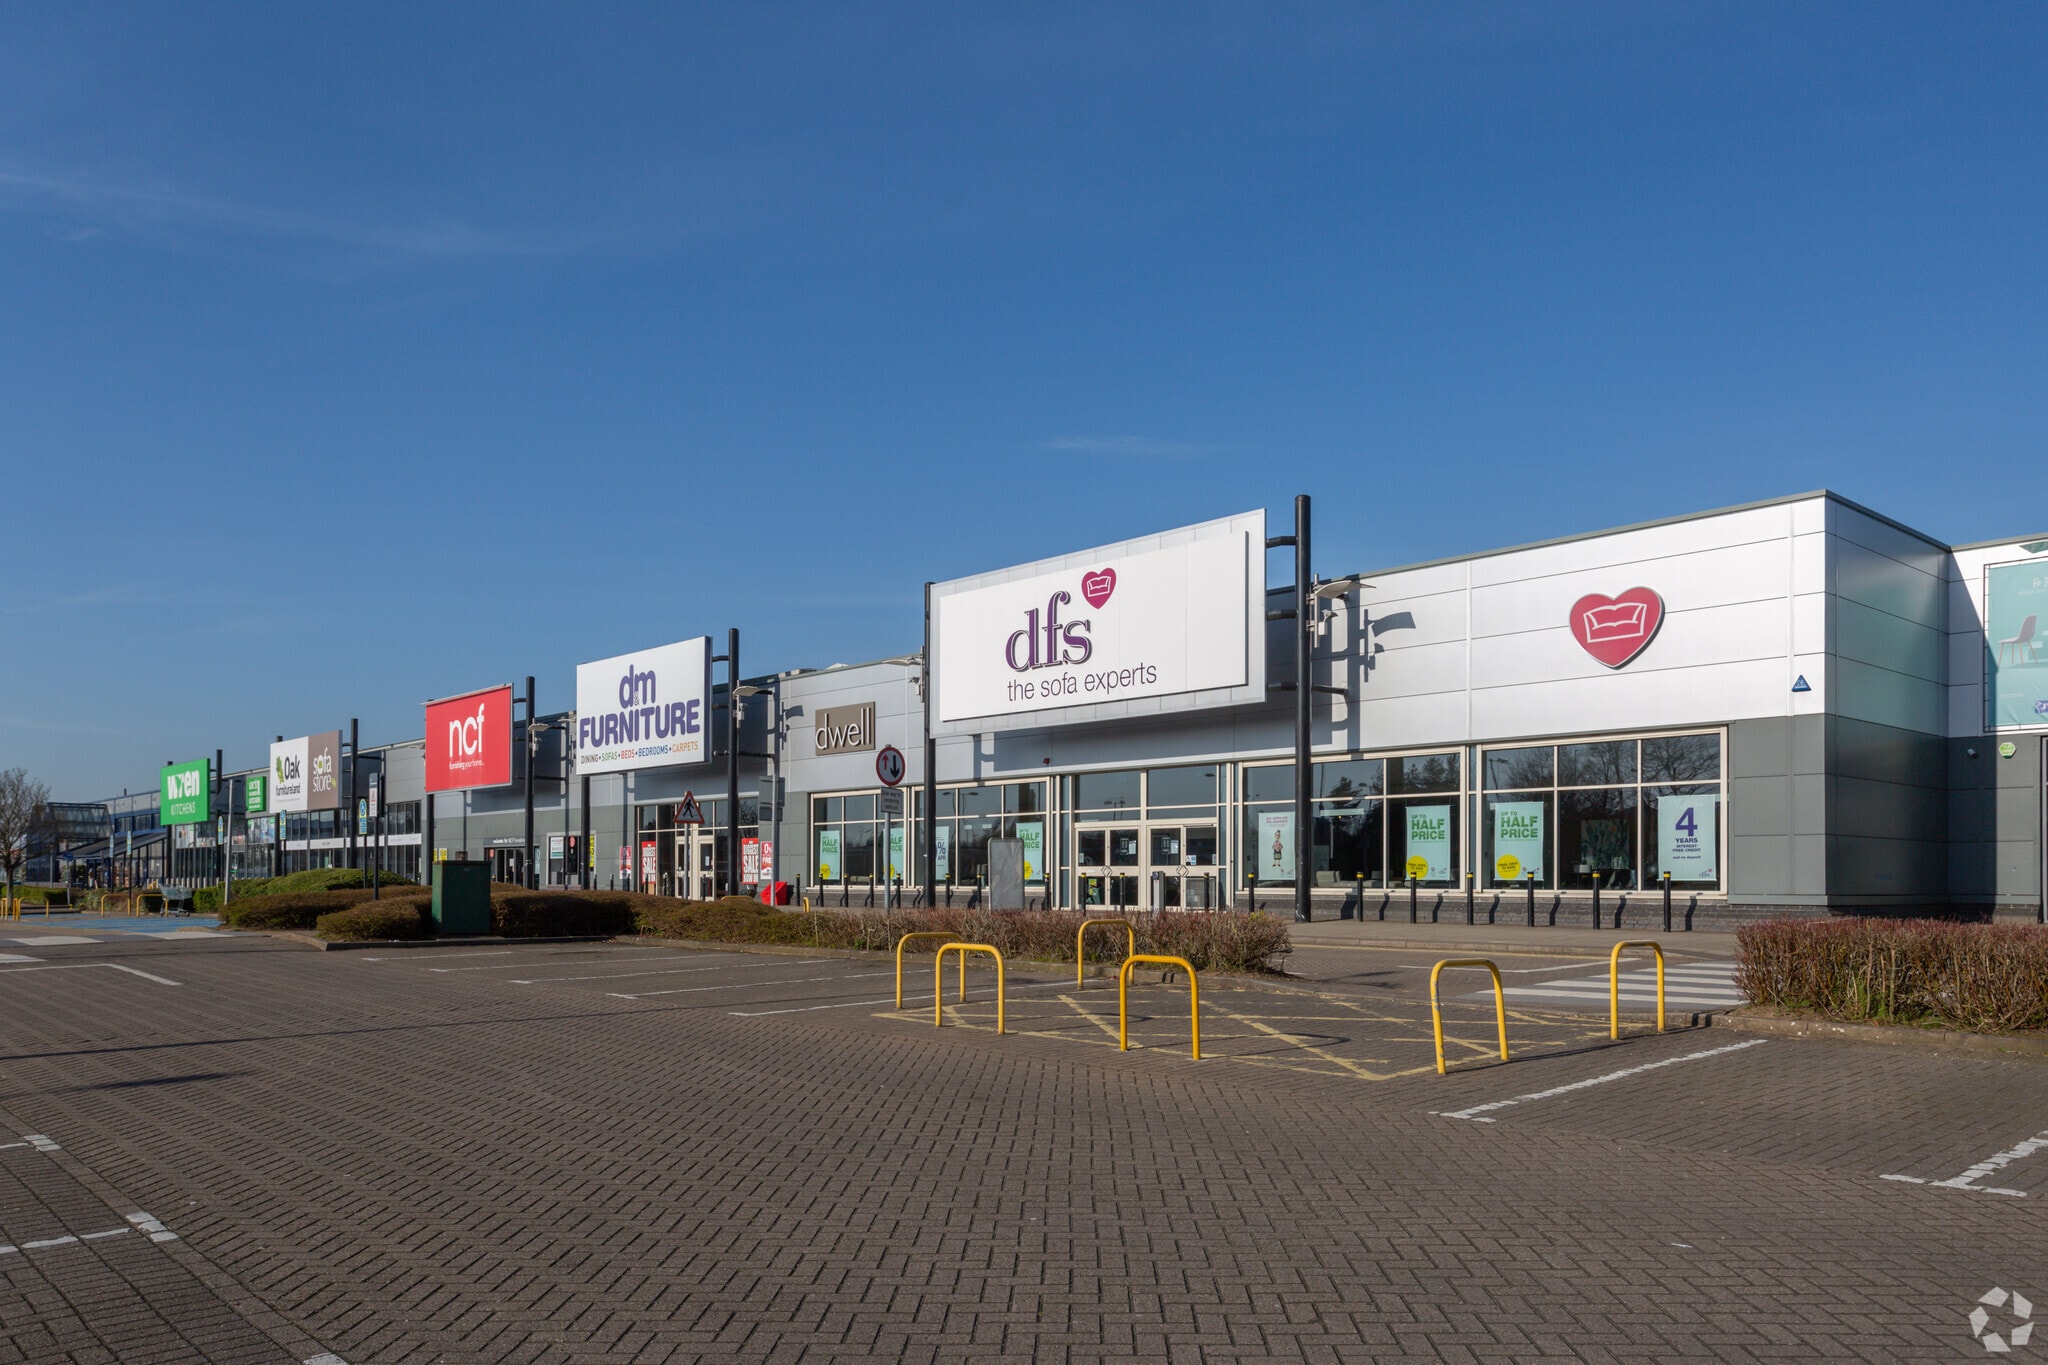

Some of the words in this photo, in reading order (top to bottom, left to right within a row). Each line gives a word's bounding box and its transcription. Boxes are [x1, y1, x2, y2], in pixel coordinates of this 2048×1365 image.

[1005, 591, 1093, 673] dfs
[1007, 679, 1035, 702] the
[1040, 671, 1078, 698] sofa
[1084, 662, 1157, 695] experts
[449, 703, 485, 758] ncf
[580, 698, 701, 750] FURNITURE
[815, 707, 872, 750] dwell
[313, 746, 332, 775] sofa
[581, 754, 599, 764] DINING
[601, 751, 618, 762] SOFAS
[621, 748, 635, 760] BEDS
[638, 744, 669, 758] BEDROOMS
[672, 740, 699, 754] CARPETS
[284, 754, 301, 781] Oak
[312, 774, 332, 793] store
[171, 801, 196, 816] KITCHENS
[1411, 818, 1445, 830] HALF
[1501, 815, 1538, 828] HALF
[1675, 807, 1698, 837] 4
[822, 839, 838, 847] HALF
[890, 836, 903, 845] ALF
[1411, 830, 1446, 840] PRICE
[1501, 828, 1538, 839] PRICE
[822, 846, 838, 854] PRICE
[1024, 840, 1040, 849] RICE
[643, 856, 656, 874] SALE
[743, 855, 758, 874] SALE
